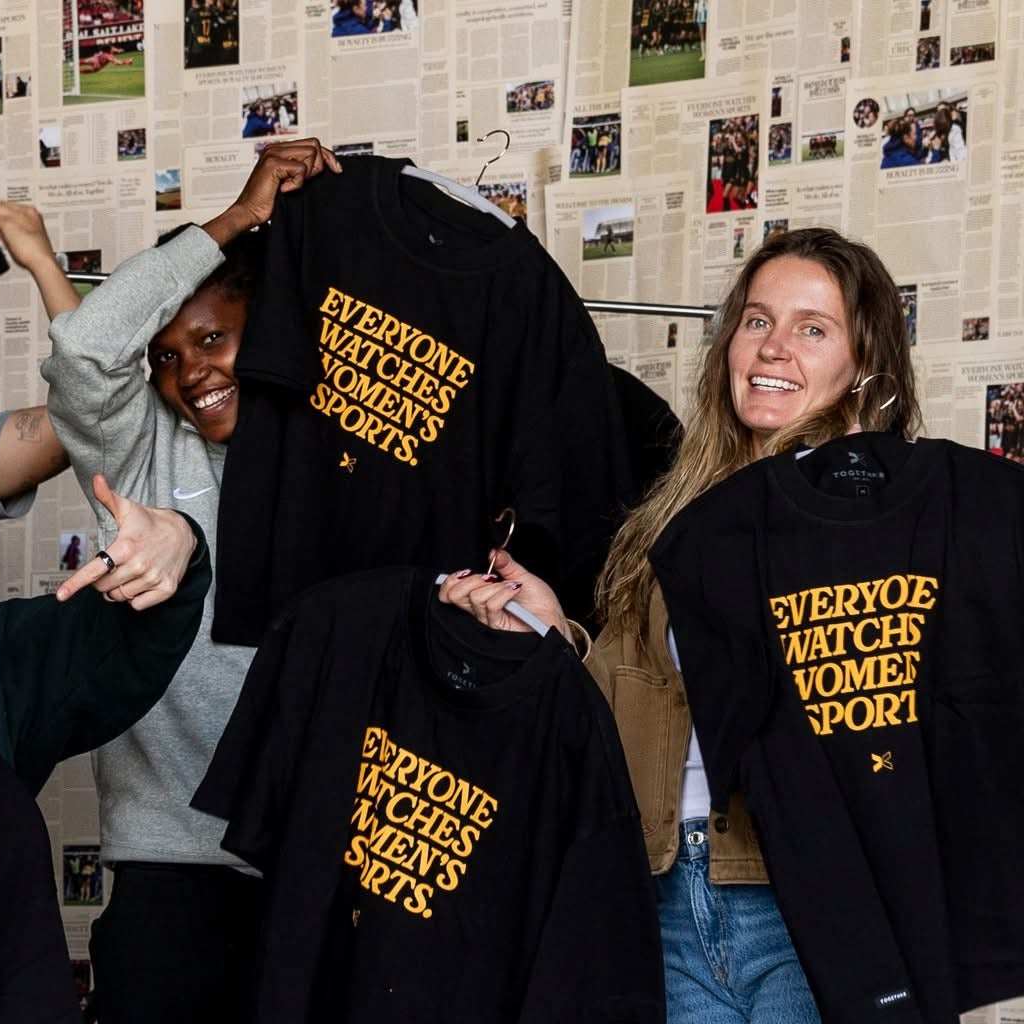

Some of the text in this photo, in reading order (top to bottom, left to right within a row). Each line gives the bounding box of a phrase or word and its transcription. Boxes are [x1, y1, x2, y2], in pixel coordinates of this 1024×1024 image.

[319, 287, 475, 389] EVERYONE
[319, 317, 456, 414] WATCHES
[310, 383, 419, 466] SPORTS.
[770, 574, 939, 629] EVERYOE
[780, 613, 925, 665] WATCHS
[351, 798, 467, 891] WMEN'S
[357, 762, 481, 858] WTCHES
[344, 835, 434, 918] SRTS.
